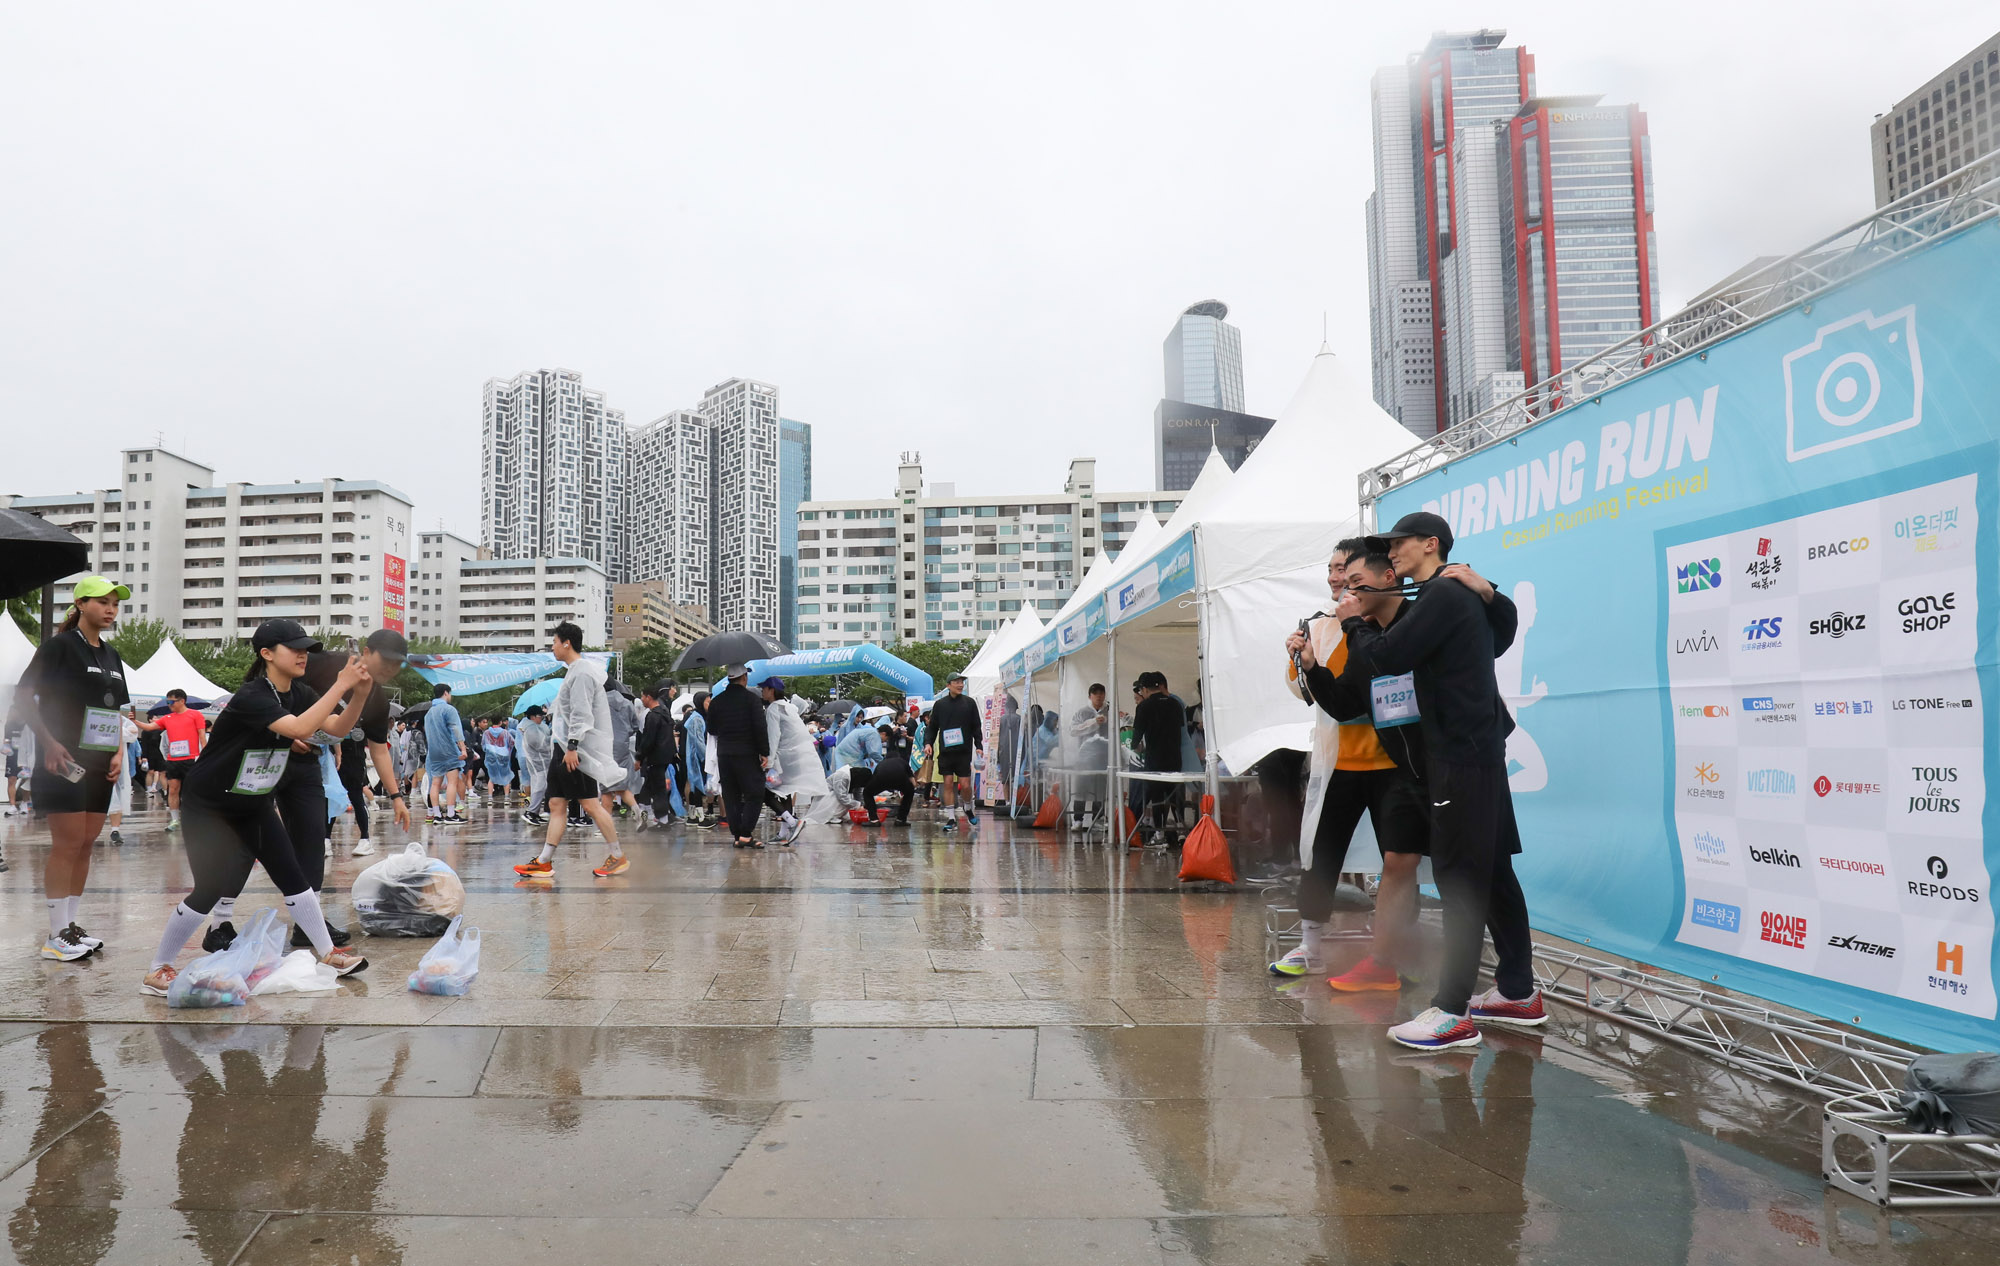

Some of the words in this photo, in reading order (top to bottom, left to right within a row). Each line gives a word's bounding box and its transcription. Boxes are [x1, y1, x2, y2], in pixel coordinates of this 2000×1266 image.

[1167, 418, 1220, 428] CONRAD
[1595, 384, 1720, 492] RUN
[1502, 521, 1550, 549] Casual
[1554, 497, 1620, 533] Running
[1625, 466, 1709, 510] Festival
[1895, 506, 1958, 538] 이온더핏
[1677, 558, 1721, 579] MONO
[1746, 555, 1782, 577] 석관동
[1809, 613, 1866, 636] SHOKZ
[1902, 614, 1951, 634] SHOP
[825, 648, 858, 663] RUN
[474, 663, 532, 687] Running
[1376, 696, 1382, 704] M
[1384, 690, 1414, 704] 1237
[1752, 700, 1773, 709] CNS
[1774, 702, 1796, 711] power
[1892, 700, 1906, 710] LG
[1909, 698, 1944, 710] TONE
[1946, 701, 1961, 709] Free
[1852, 700, 1873, 715] 놀자
[90, 723, 98, 731] W
[246, 766, 254, 774] W
[1912, 767, 1958, 782] TOUS
[1747, 769, 1796, 795] VICTORIA
[1835, 782, 1881, 794] 롯데웰푸드
[1926, 782, 1943, 797] les
[1908, 796, 1960, 814] JOURS
[1749, 845, 1801, 868] belkin
[1819, 857, 1885, 876] 닥터다이어리
[1908, 881, 1979, 902] REPODS
[1696, 904, 1737, 928] 비즈한국
[1760, 910, 1807, 950] 일요신문
[1828, 934, 1896, 958] EXTREME
[1928, 975, 1968, 995] 현대해상
